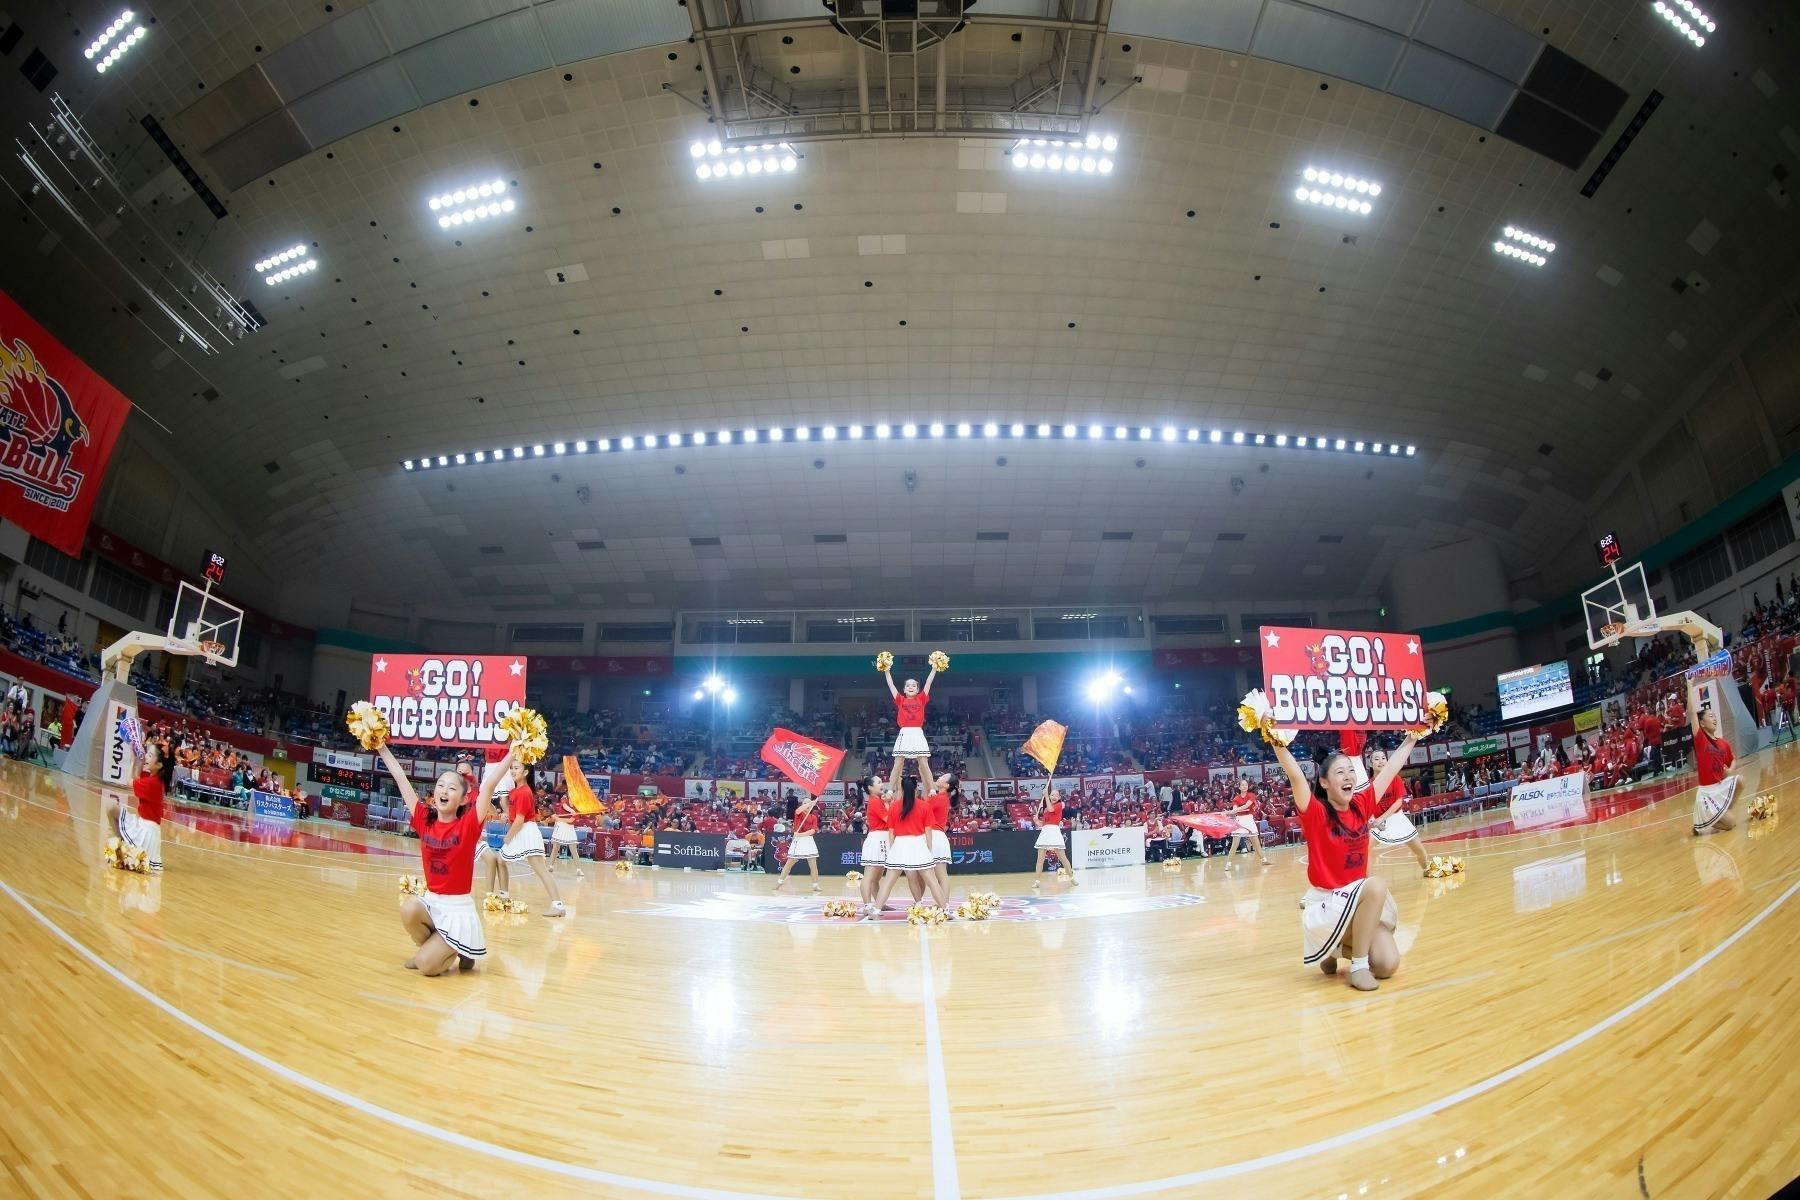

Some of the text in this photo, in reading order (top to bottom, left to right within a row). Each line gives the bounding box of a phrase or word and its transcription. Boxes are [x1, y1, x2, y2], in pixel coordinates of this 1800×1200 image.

[24, 488, 68, 510] SINCE 2011
[1600, 534, 1613, 548] 8:22
[211, 553, 225, 566] 8:22
[1603, 542, 1620, 563] 24
[206, 562, 224, 582] 24
[1322, 634, 1387, 676] GO!
[421, 659, 483, 697] GO!
[1271, 674, 1425, 724] BIGBULLS!
[360, 782, 370, 790] 45
[1519, 789, 1544, 802] ALSOK
[949, 836, 974, 846] TION
[673, 844, 720, 857] SoftBank
[1087, 847, 1131, 857] INFRONEER
